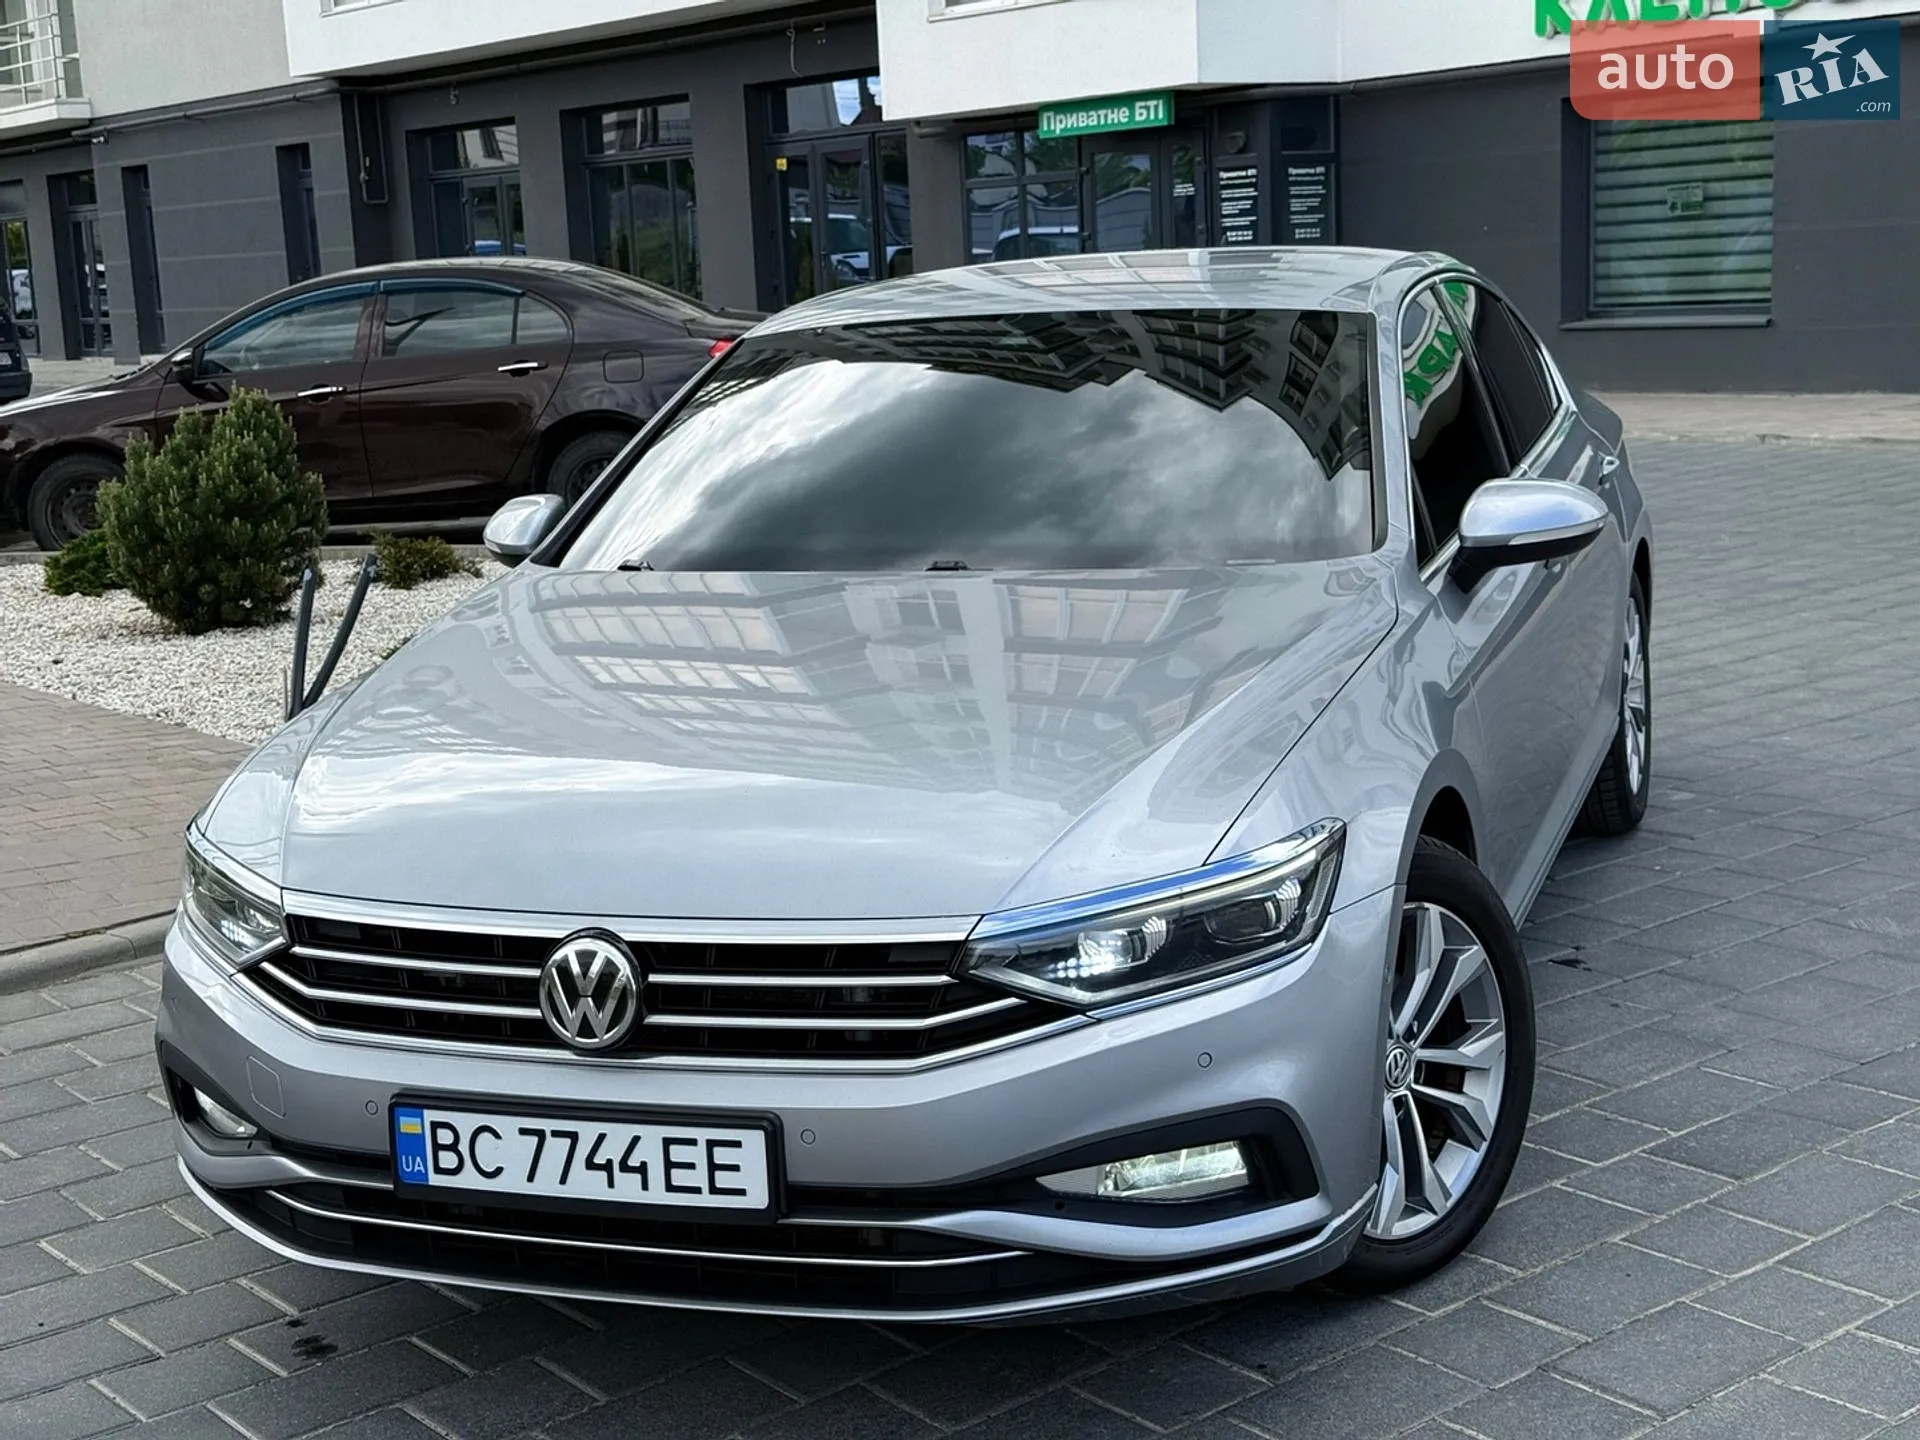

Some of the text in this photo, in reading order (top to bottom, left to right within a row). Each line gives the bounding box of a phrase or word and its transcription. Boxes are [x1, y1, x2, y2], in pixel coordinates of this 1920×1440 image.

[1042, 100, 1163, 135] Приватне БТІ
[545, 942, 632, 1043] VW
[401, 1154, 426, 1174] UA
